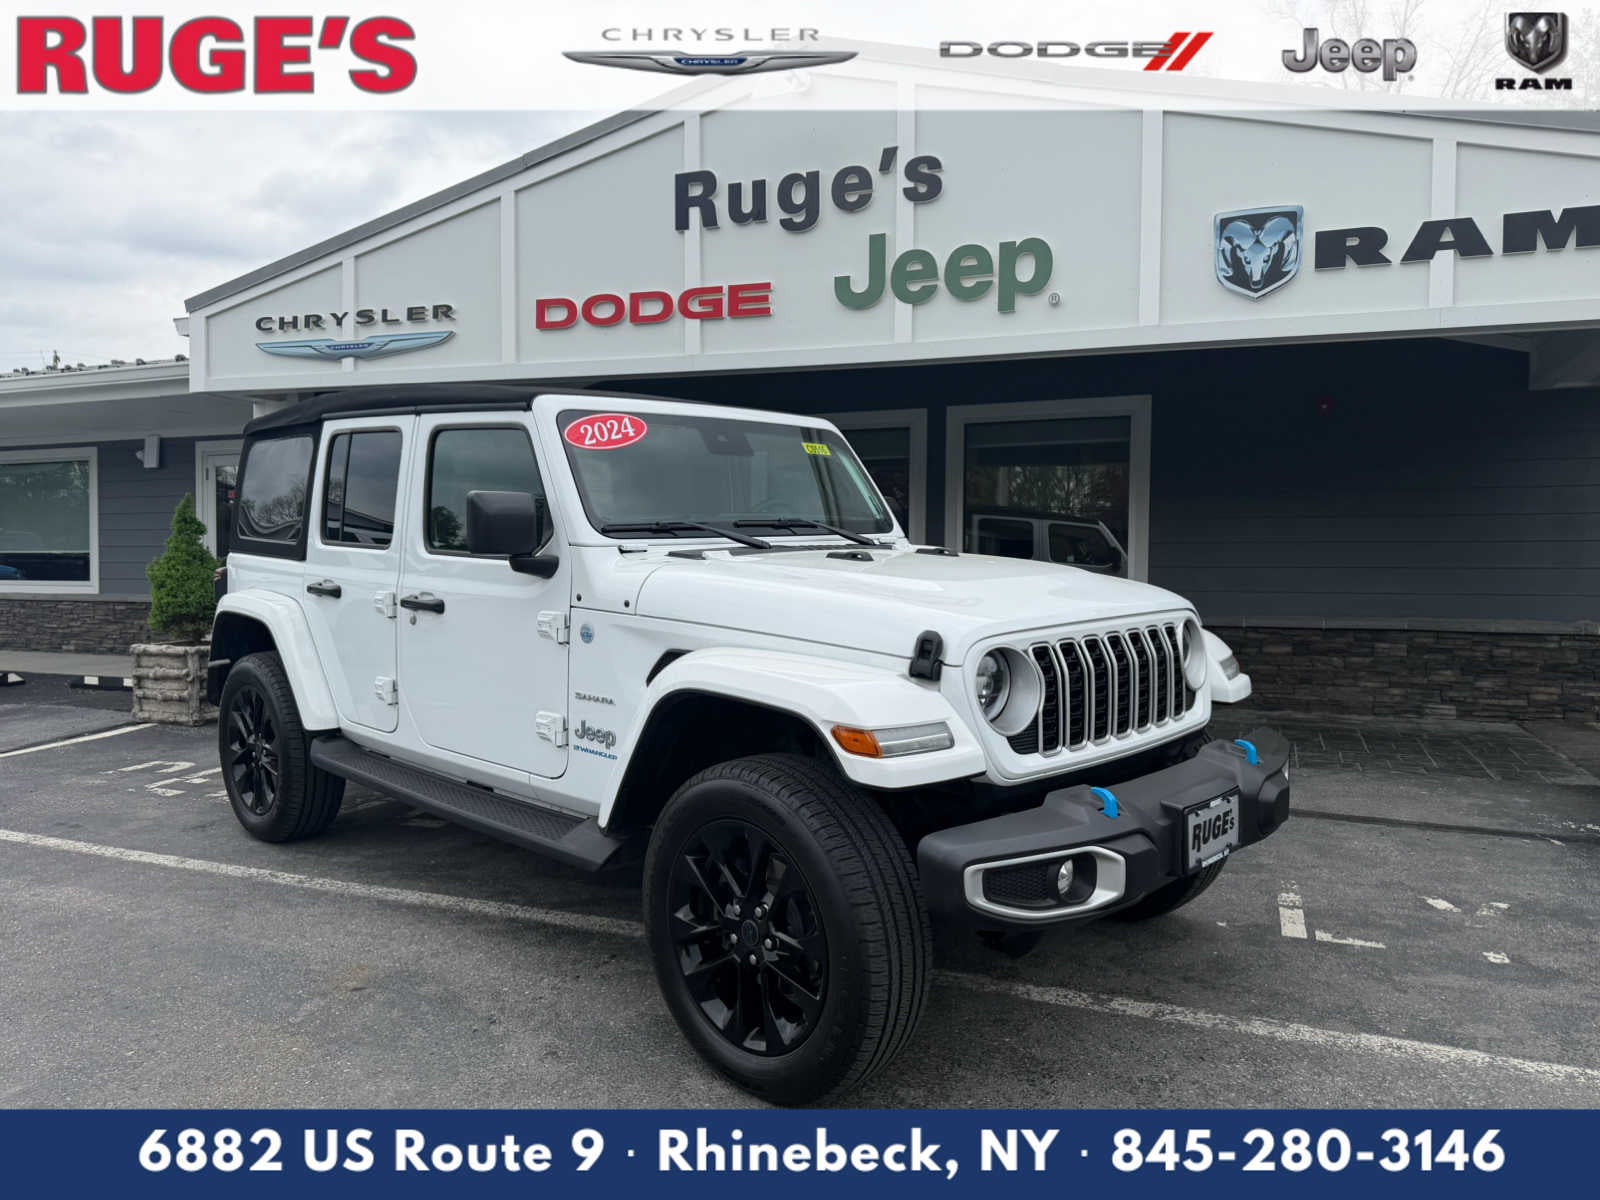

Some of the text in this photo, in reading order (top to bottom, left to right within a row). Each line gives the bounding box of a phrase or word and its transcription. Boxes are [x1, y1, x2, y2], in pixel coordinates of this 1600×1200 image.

[674, 146, 943, 233] Ruge's
[1315, 205, 1600, 270] RAM
[834, 233, 1053, 313] Jeep
[255, 304, 456, 331] CHRYSLER
[536, 282, 772, 330] DODGE
[580, 416, 636, 445] 2024
[574, 719, 617, 749] Jeep
